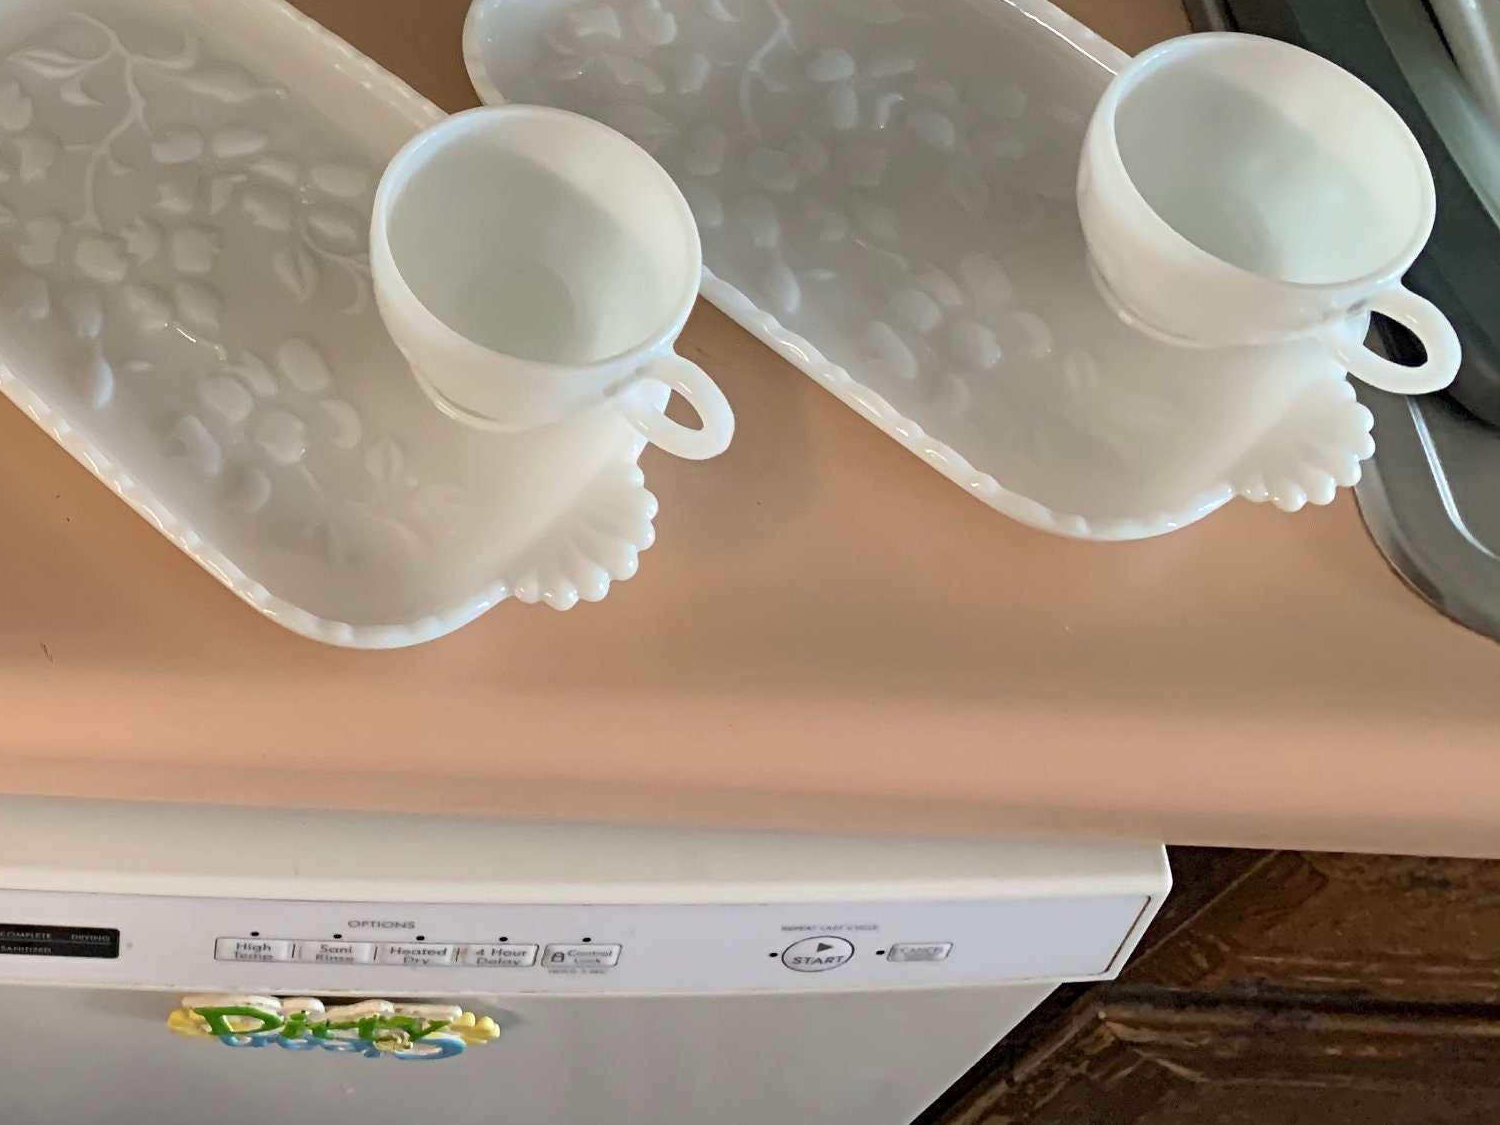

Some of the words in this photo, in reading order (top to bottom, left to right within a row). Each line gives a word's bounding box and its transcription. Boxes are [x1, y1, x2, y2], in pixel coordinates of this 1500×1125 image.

[348, 920, 415, 930] OPTIONS
[235, 941, 272, 954] High
[320, 944, 353, 955] Sani
[390, 945, 448, 957] Heated
[475, 947, 485, 957] 4
[491, 948, 527, 958] Hour
[403, 955, 430, 966] Dry
[476, 956, 522, 967] Delay
[792, 955, 845, 965] START
